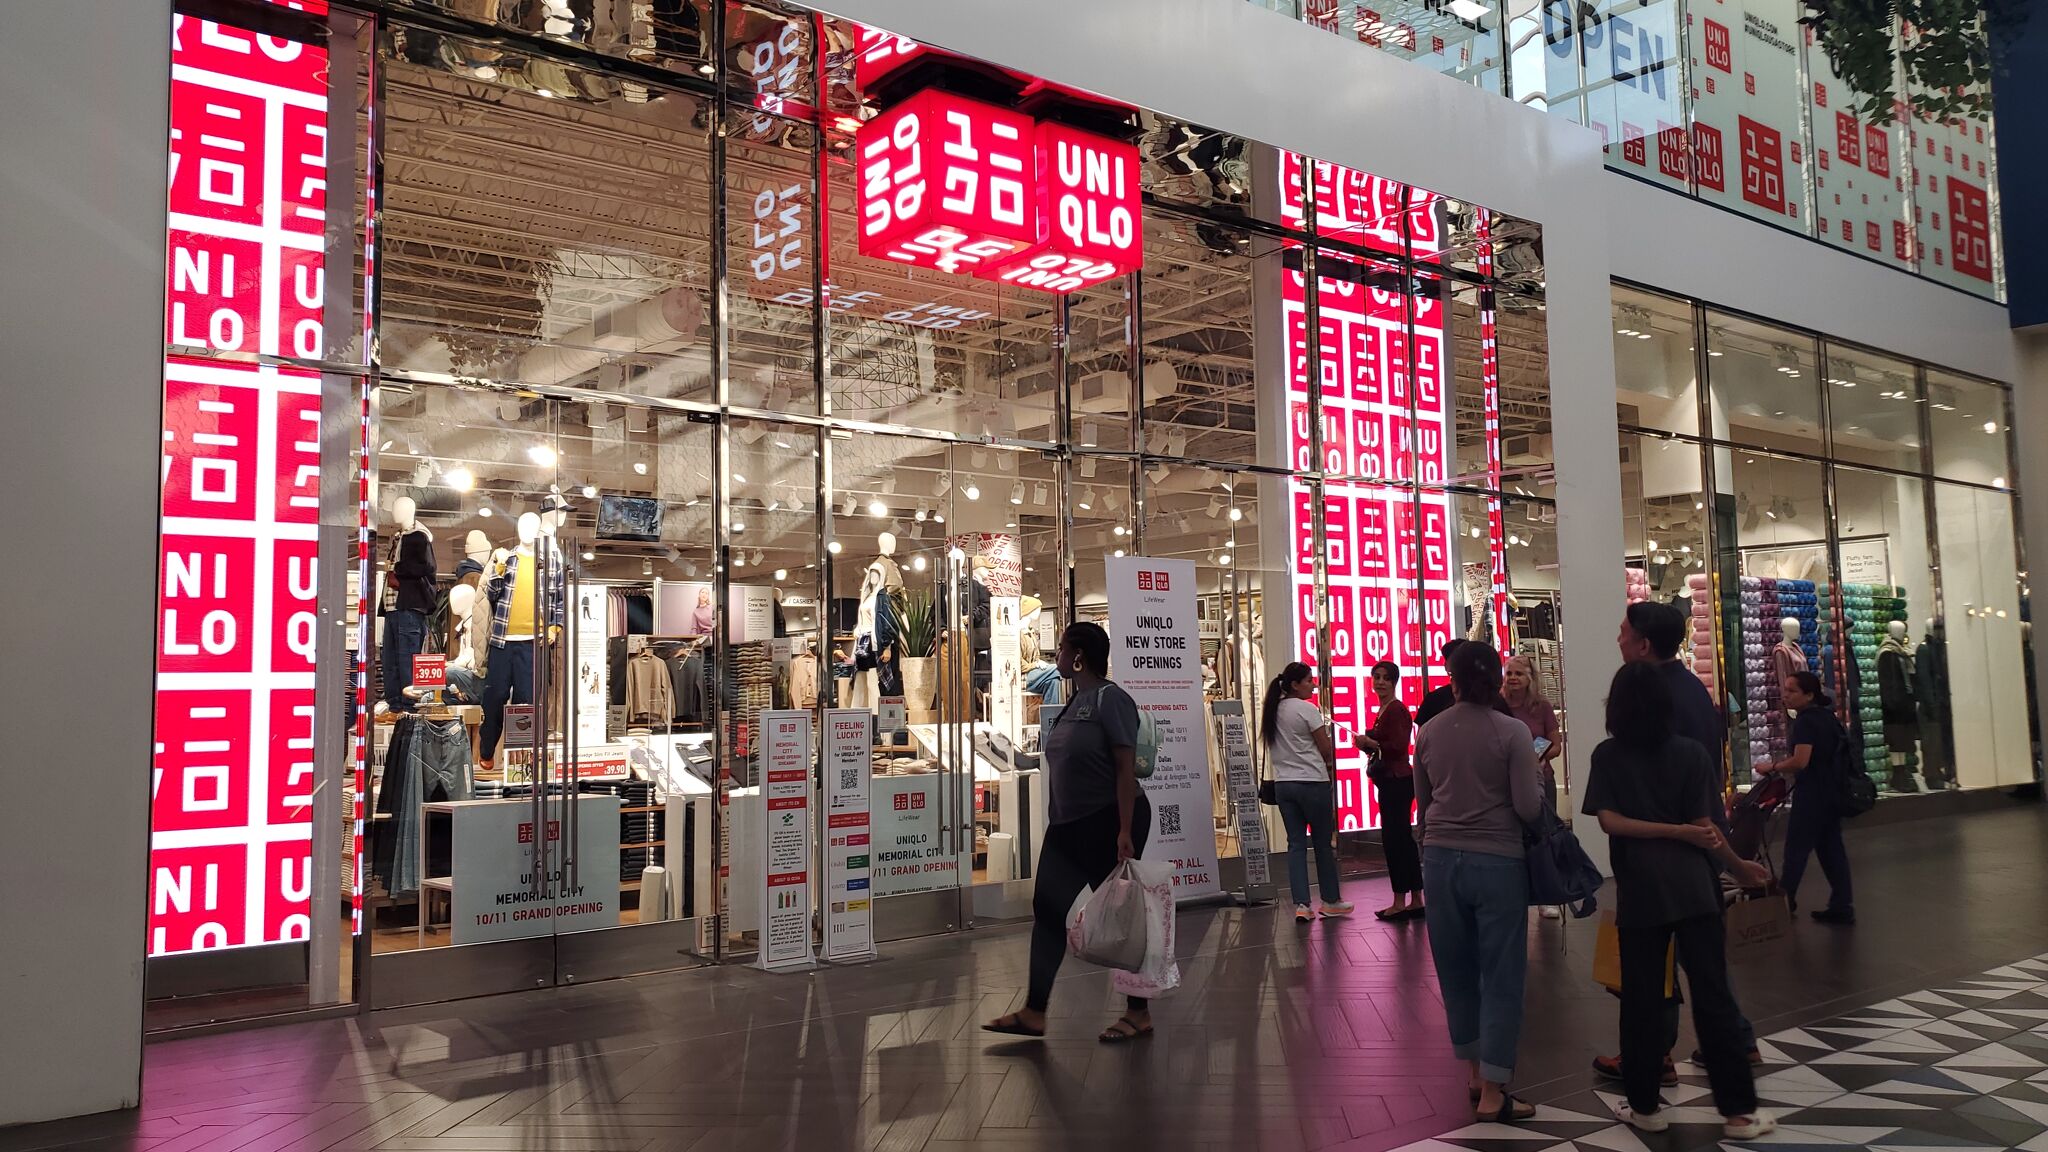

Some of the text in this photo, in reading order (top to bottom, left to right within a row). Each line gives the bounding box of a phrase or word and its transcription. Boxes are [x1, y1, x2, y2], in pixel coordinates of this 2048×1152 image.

[1707, 24, 1726, 47] UNI
[1544, 0, 1666, 100] OPEN
[1708, 44, 1729, 67] QLO
[944, 110, 1022, 172] ユニ
[1746, 128, 1777, 167] ユニ
[893, 112, 926, 221] QLO
[1057, 140, 1125, 199] UNI
[865, 136, 891, 237] UNI
[1747, 164, 1779, 202] クロ
[943, 165, 1024, 226] クロ
[1060, 194, 1133, 249] QLO
[1954, 191, 1985, 230] ユニ
[1956, 230, 1987, 269] クロ
[1001, 267, 1084, 291] UNI
[1029, 254, 1117, 280] QLO
[165, 552, 227, 598] NI
[164, 609, 237, 655] LO
[1136, 616, 1173, 631] UNIQLO
[1126, 636, 1186, 649] NEW STORE
[415, 668, 442, 679] $39.90
[1132, 656, 1182, 669] OPENINGS
[835, 721, 865, 730] FEELING
[836, 731, 863, 740] LUCKY?
[604, 764, 625, 775] $39.90
[912, 800, 924, 808] QLO
[896, 833, 927, 845] UNIQLO
[878, 849, 923, 862] MEMORIAL
[1186, 857, 1205, 869] ALL.
[890, 863, 920, 876] GRAND
[1184, 872, 1211, 885] TEXAS.
[155, 863, 218, 915] NI
[475, 901, 604, 926] 10/11 GRAND OPENING
